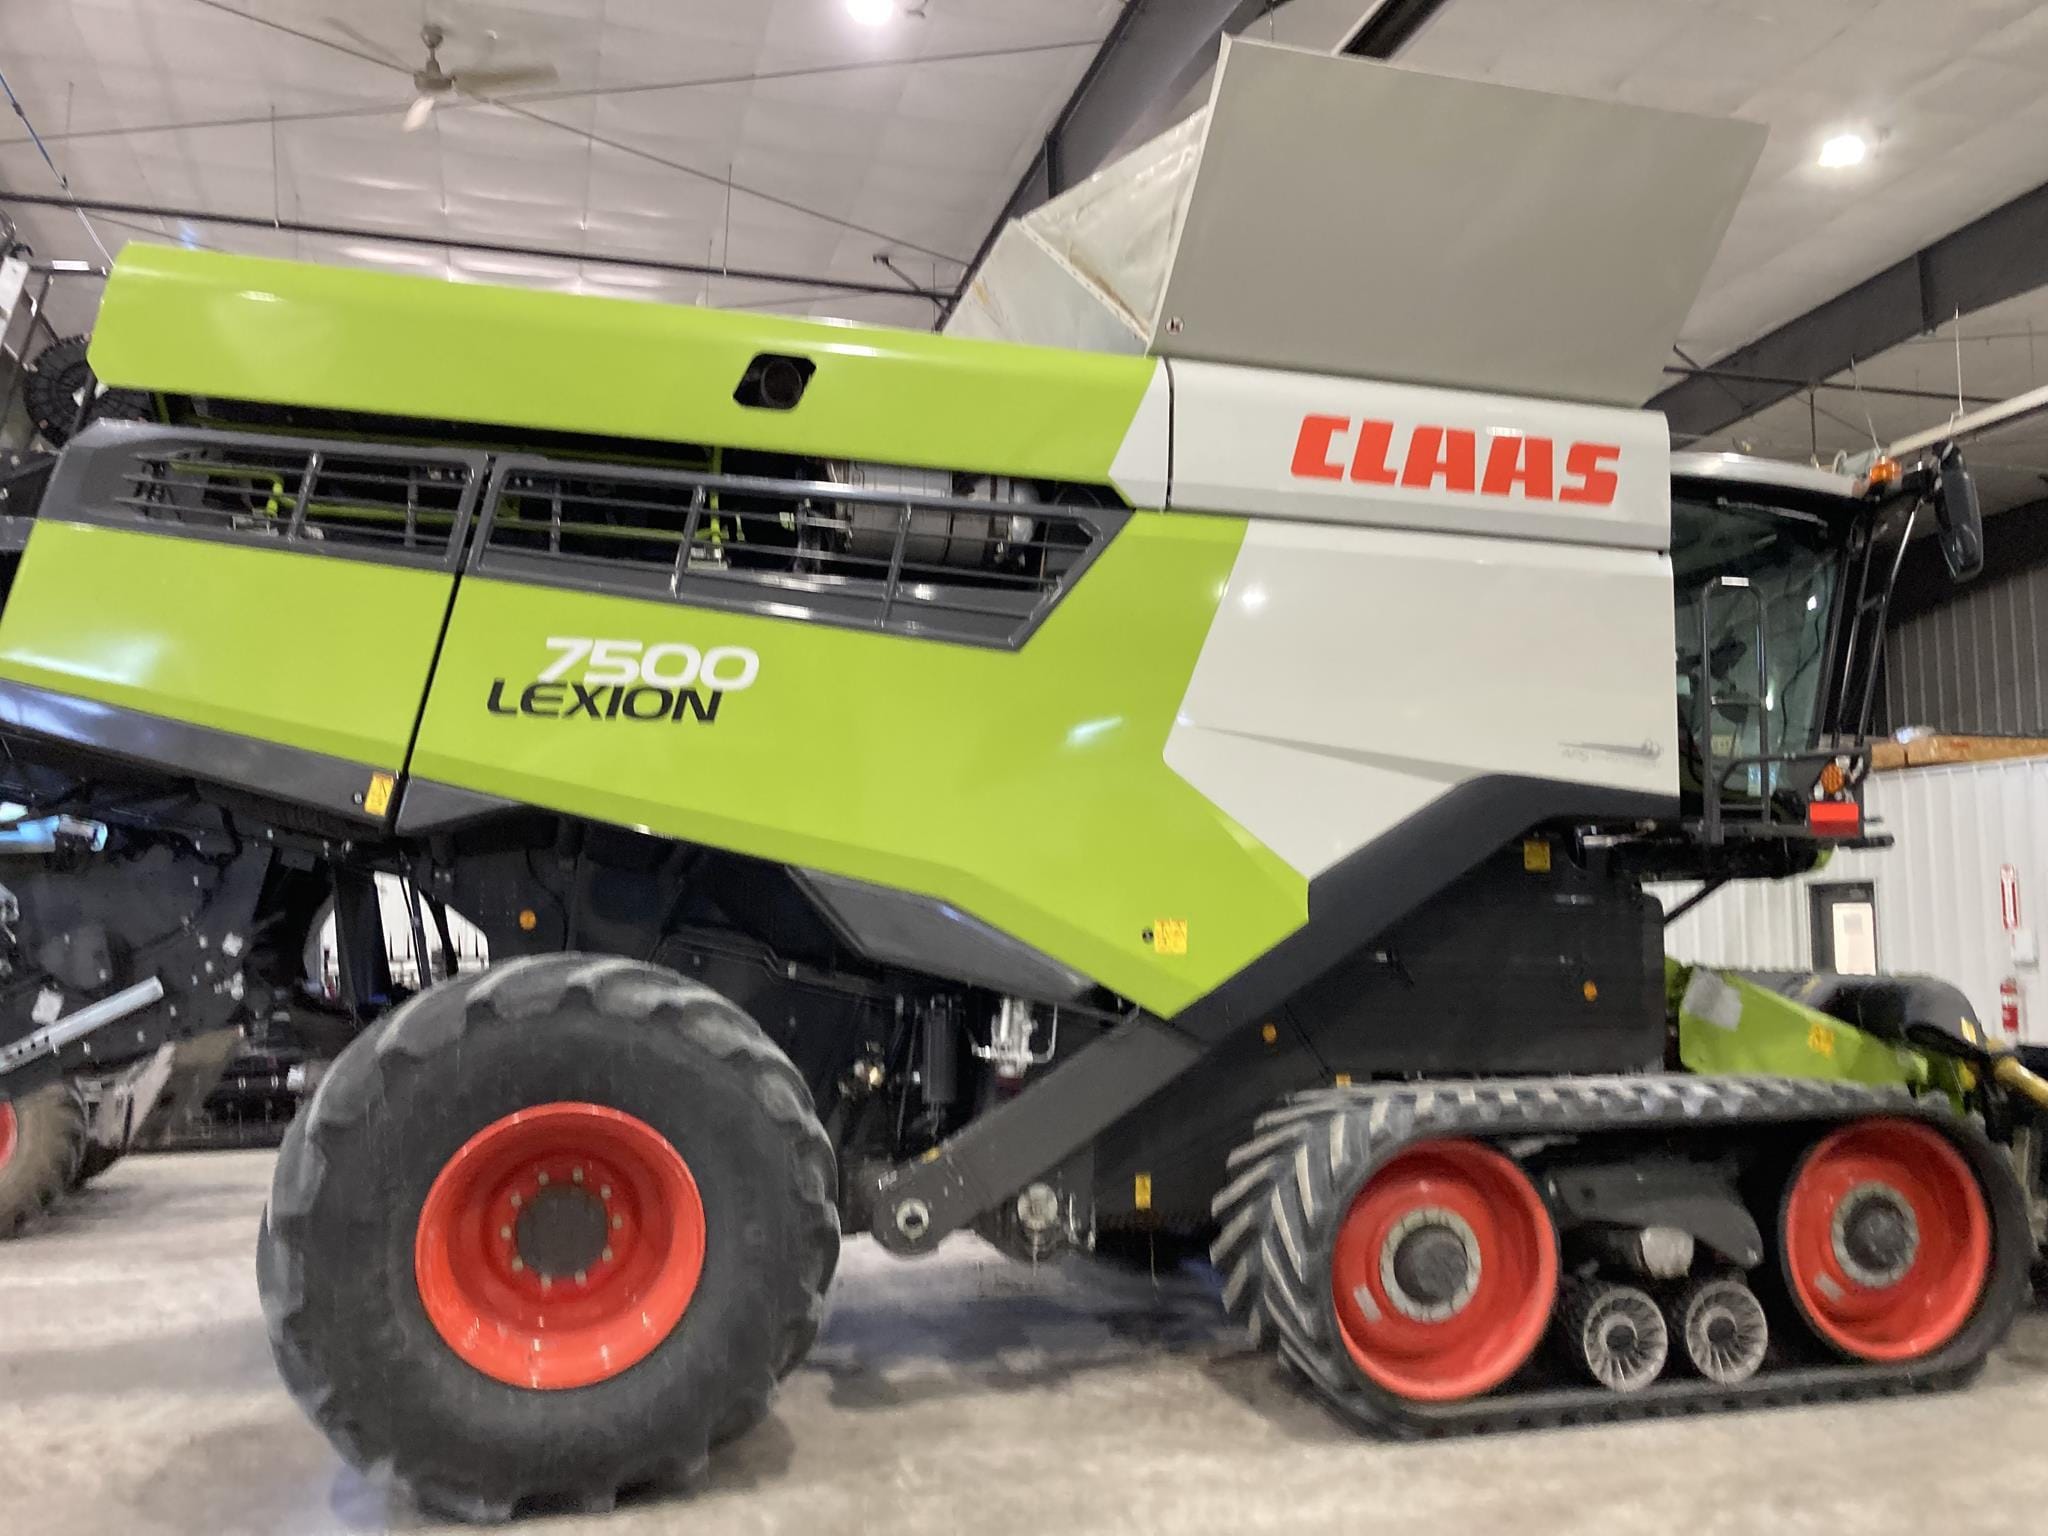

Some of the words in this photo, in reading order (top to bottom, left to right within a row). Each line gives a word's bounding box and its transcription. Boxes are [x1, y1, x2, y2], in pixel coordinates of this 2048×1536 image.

[1291, 413, 1620, 507] CLAAS
[537, 636, 759, 691] 7500
[487, 678, 723, 725] LEXION
